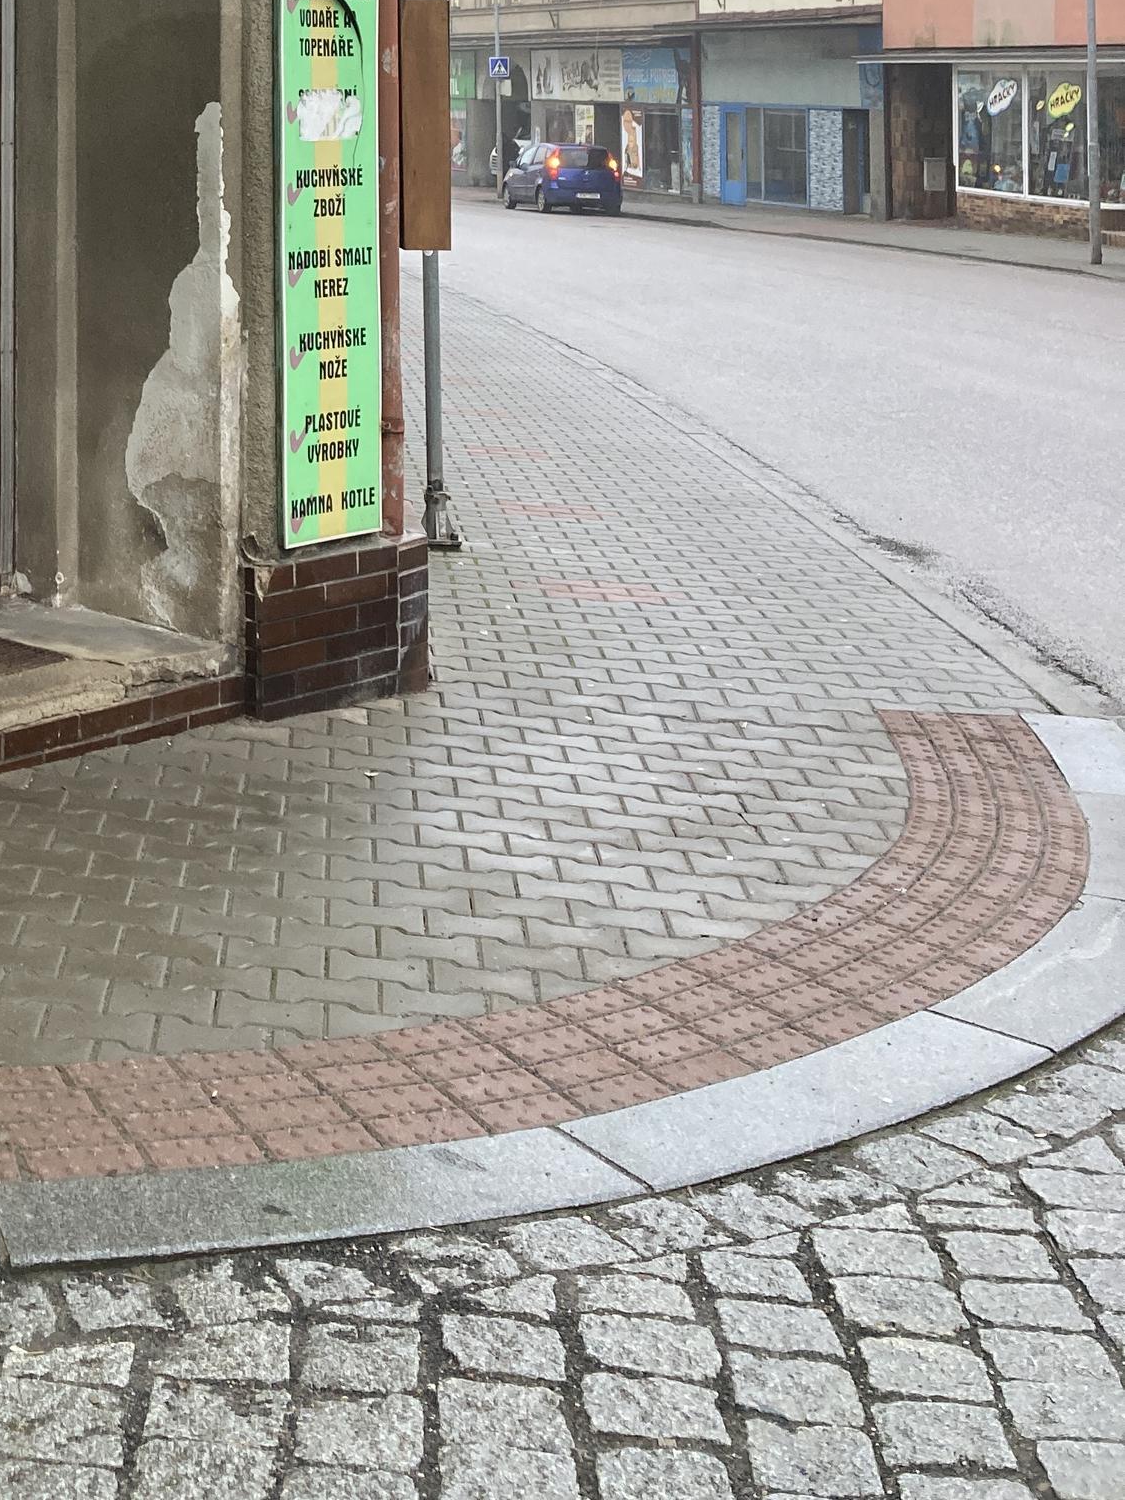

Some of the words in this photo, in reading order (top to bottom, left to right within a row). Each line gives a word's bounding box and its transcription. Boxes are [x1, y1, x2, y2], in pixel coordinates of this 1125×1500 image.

[299, 6, 339, 28] VODAŘE
[299, 34, 354, 57] TOPENÁŘE
[296, 164, 363, 189] KUCHYŇSKÉ
[313, 193, 346, 217] ZBOŽÍ
[288, 245, 331, 271] NÁDOBÍ
[335, 246, 373, 267] SMALT
[314, 277, 349, 298] NEREZ
[319, 355, 348, 380] NOŽE
[305, 404, 361, 434] PLASTOVÉ
[307, 438, 359, 464] VÝROBKY
[291, 493, 333, 519] KAMNA
[341, 487, 375, 510] KOTLE
